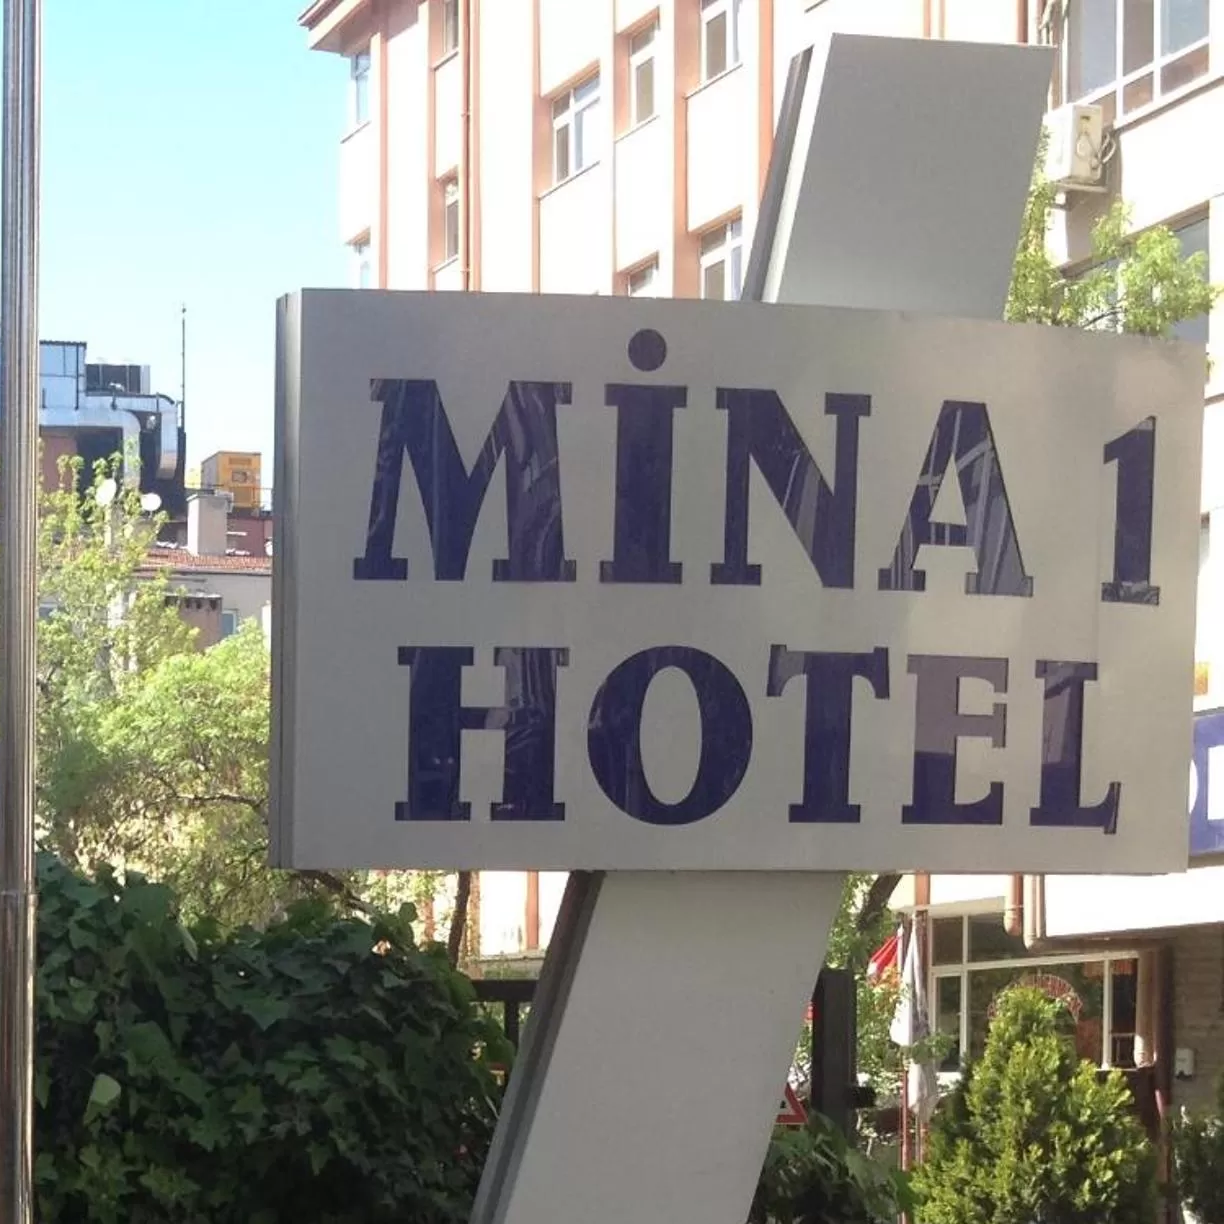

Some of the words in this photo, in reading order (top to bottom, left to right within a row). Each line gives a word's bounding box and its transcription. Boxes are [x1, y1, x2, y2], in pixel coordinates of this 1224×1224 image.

[353, 328, 1034, 597] MİNA
[1101, 415, 1161, 606] 1
[394, 645, 1122, 835] HOTEL
